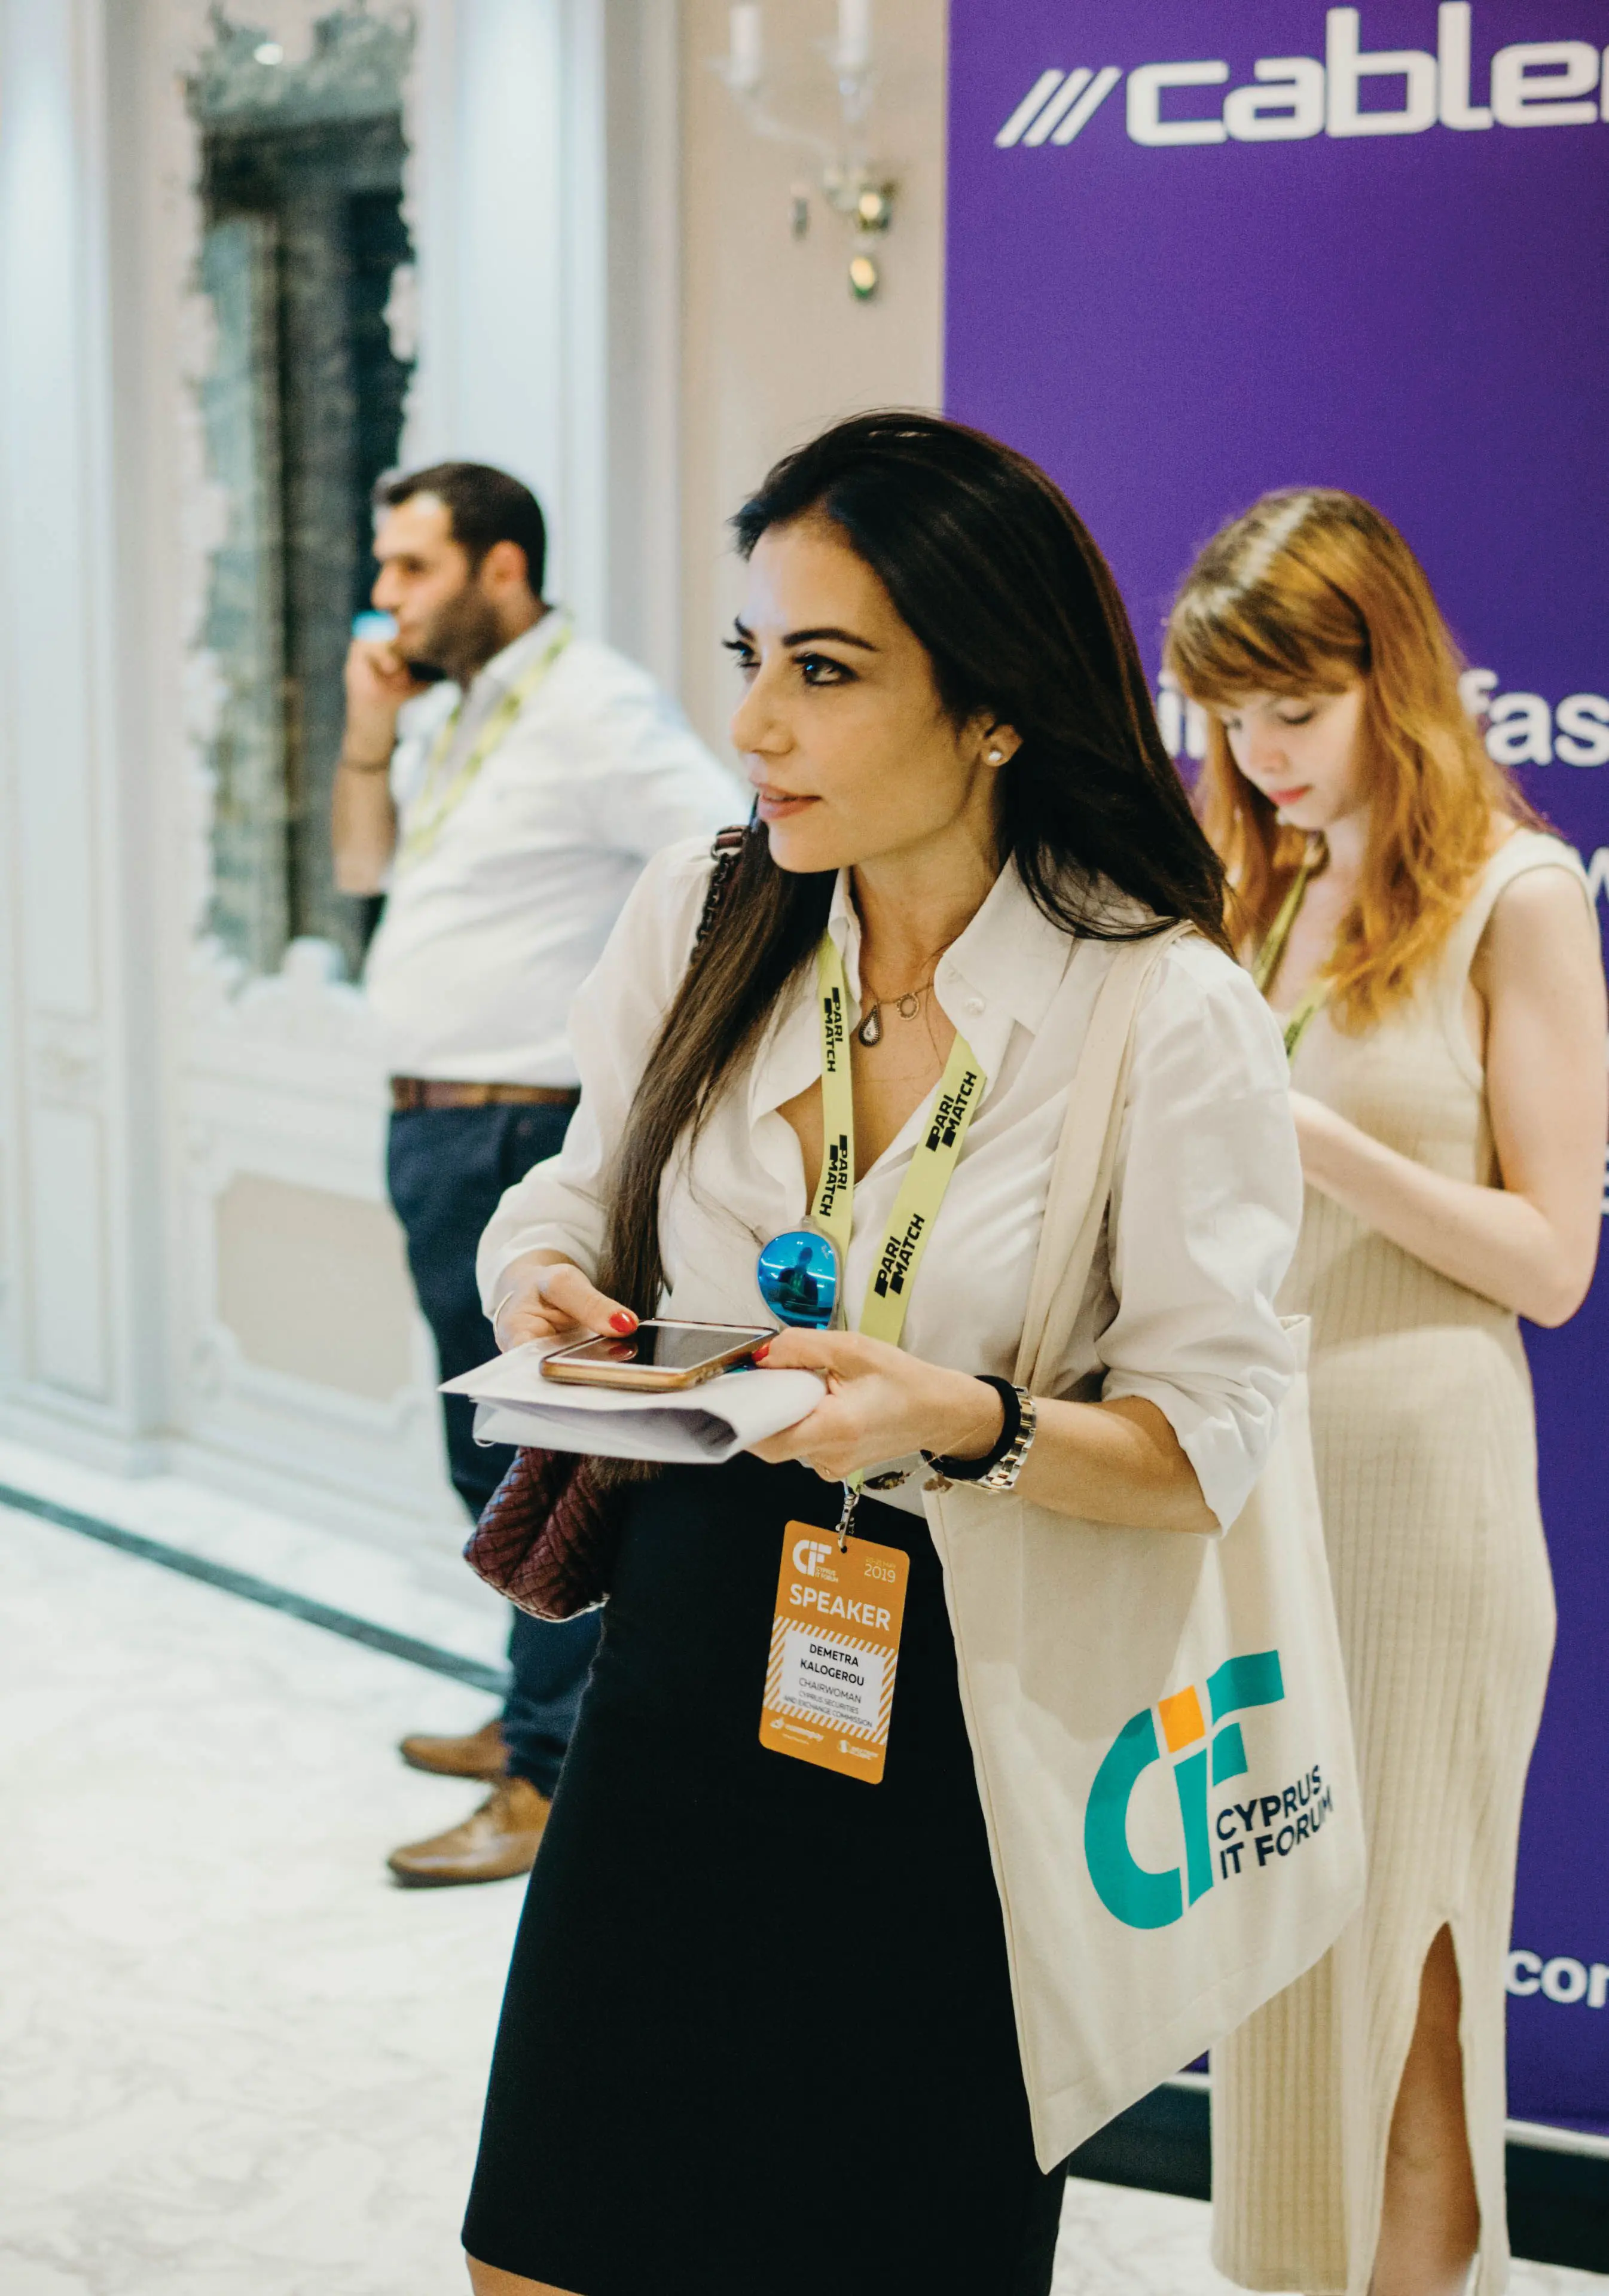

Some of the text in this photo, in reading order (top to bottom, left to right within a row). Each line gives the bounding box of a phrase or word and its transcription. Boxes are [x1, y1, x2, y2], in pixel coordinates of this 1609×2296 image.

[1126, 1, 1609, 147] cable
[824, 998, 836, 1072] MATCH
[832, 987, 843, 1042] PARI
[925, 1094, 955, 1152] PARI
[941, 1071, 977, 1148] MATCH
[819, 1144, 838, 1217] MATCH
[837, 1134, 848, 1190] PARI
[874, 1235, 901, 1298] PARI
[889, 1213, 925, 1294] MATCH
[864, 1563, 896, 1583] 2019
[789, 1583, 891, 1631] SPEAKER
[800, 1658, 865, 1686] KALOGEROU
[809, 1643, 859, 1667] DEMETRA
[799, 1677, 862, 1703] CHAIRWOMAN
[825, 1698, 859, 1715] SECURITIES
[1216, 1764, 1322, 1841] CYPRUS
[1220, 1784, 1334, 1880] IT FORUM
